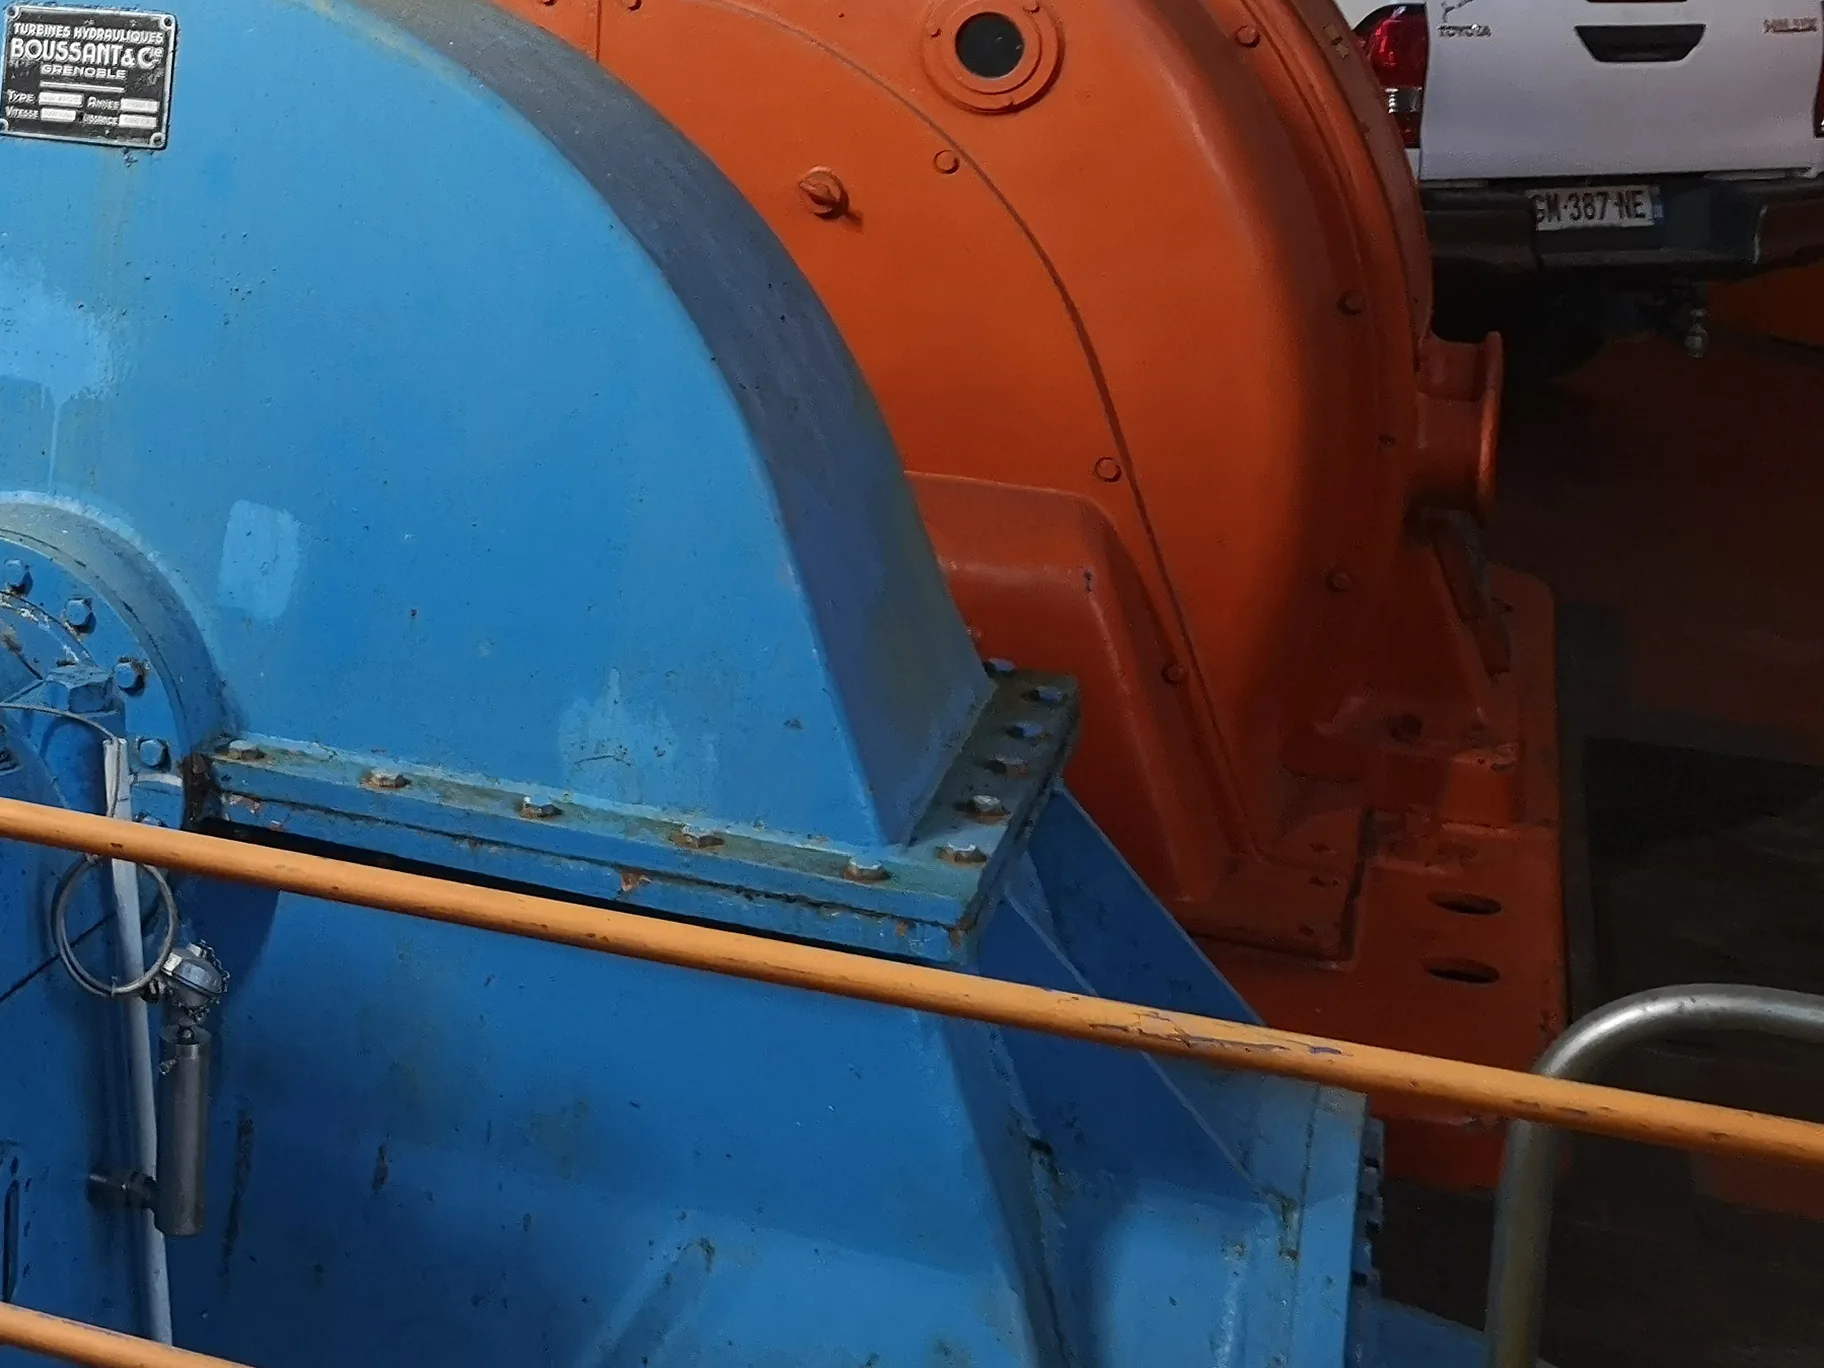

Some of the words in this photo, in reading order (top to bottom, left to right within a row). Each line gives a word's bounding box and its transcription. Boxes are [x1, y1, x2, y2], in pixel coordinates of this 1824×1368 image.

[13, 22, 71, 38] TURBINES
[74, 27, 164, 44] HYDRAULIQUES
[10, 37, 121, 66] BOUSSANT
[40, 64, 126, 79] GRENOBLE
